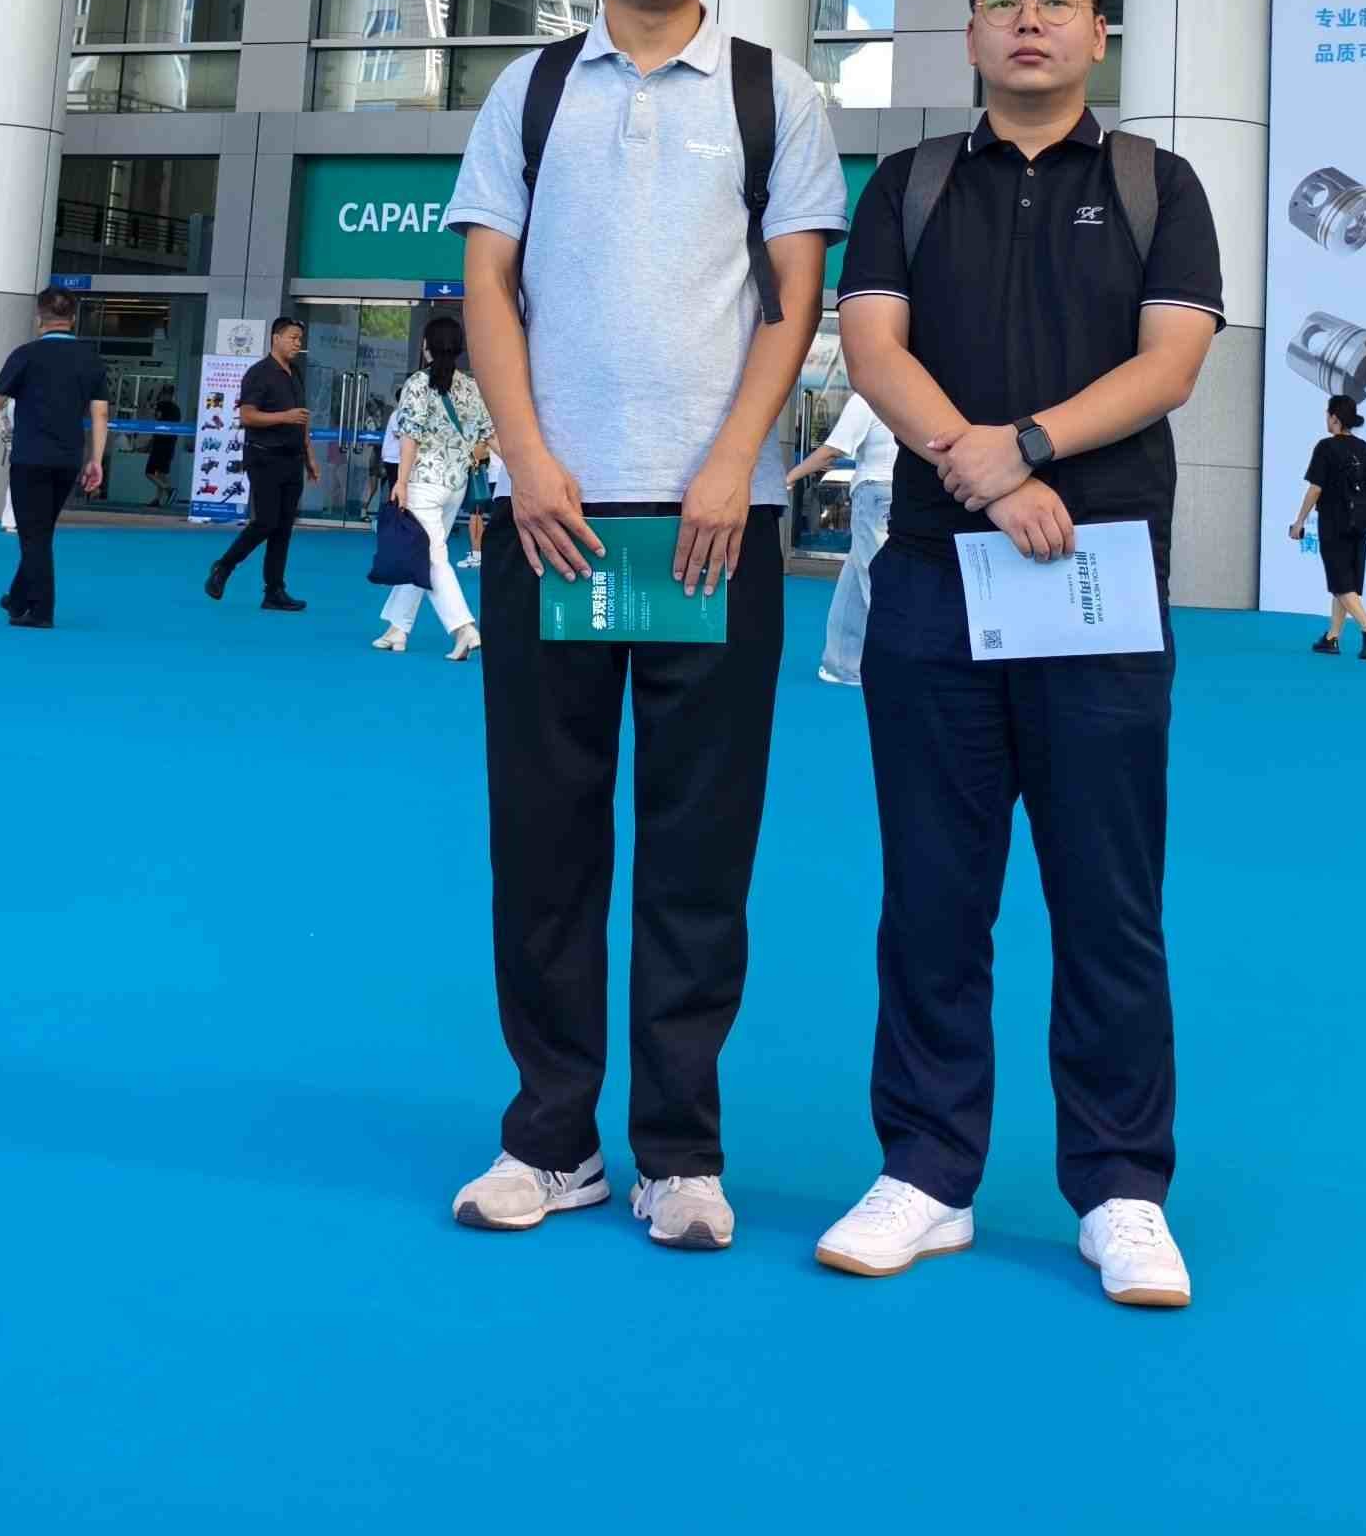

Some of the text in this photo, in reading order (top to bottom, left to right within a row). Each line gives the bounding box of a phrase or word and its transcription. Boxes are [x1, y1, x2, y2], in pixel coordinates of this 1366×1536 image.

[591, 571, 608, 631] 参观指南
[607, 571, 616, 597] GUIDE
